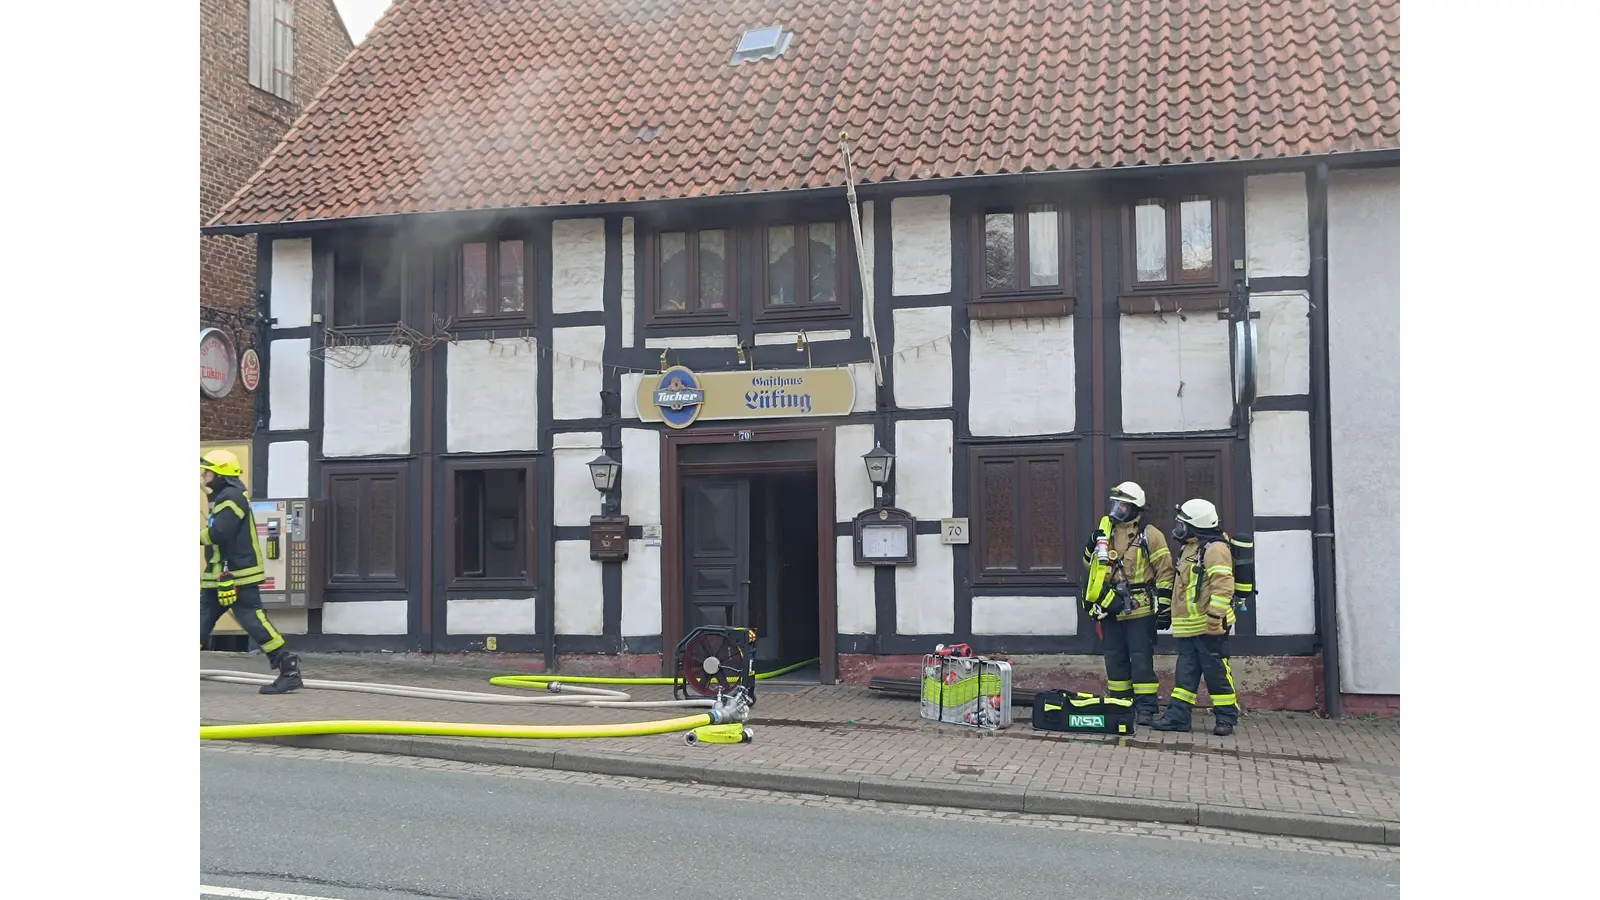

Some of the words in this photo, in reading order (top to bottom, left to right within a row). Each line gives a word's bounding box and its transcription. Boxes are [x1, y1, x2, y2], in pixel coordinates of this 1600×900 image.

[658, 392, 698, 402] Tucher
[744, 390, 812, 413] Lüking
[739, 432, 750, 440] 70
[948, 526, 962, 536] 70
[1071, 716, 1103, 726] MSA
